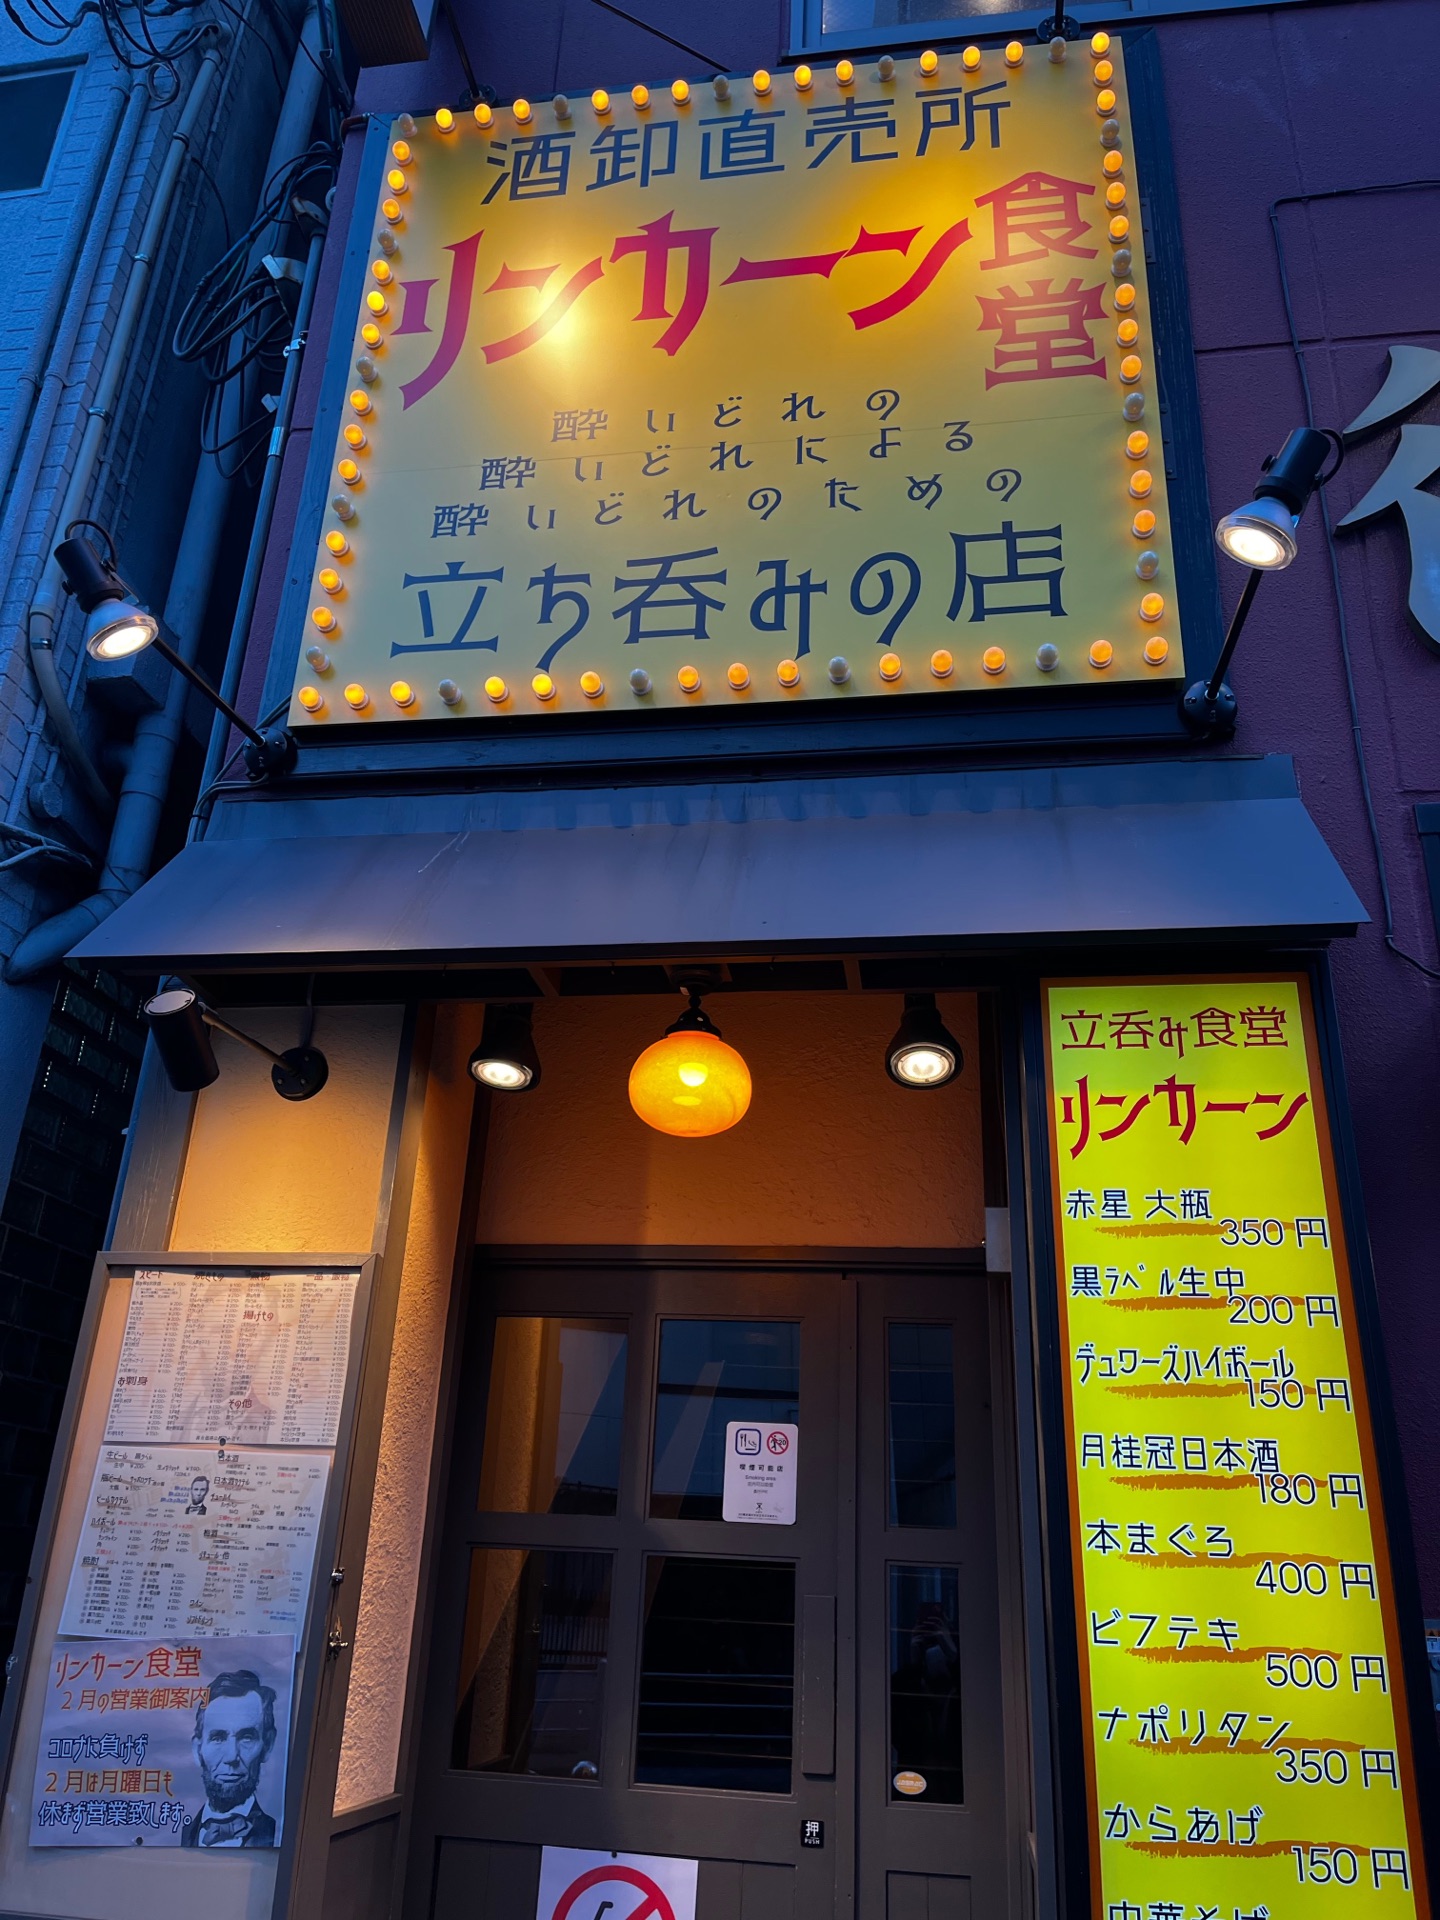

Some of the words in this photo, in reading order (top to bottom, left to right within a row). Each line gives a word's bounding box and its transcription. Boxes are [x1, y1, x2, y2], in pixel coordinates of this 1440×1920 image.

[480, 81, 1011, 205] 酒卸直売所
[975, 170, 1108, 391] 食堂
[391, 210, 973, 411] リンカーン
[551, 388, 901, 443] 酔いどれの
[479, 421, 975, 491] 酔いどれによる
[430, 469, 1022, 540] 酔いどれのための
[390, 521, 1068, 674] 立ち呑みの店
[1061, 1006, 1289, 1059] 立呑み食堂
[1060, 1074, 1309, 1160] リンカーン
[1066, 1190, 1132, 1220] 赤星
[117, 1376, 148, 1388] お刺身
[1076, 1342, 1295, 1384] デュワーズハイボール
[228, 1398, 252, 1410] その他
[1081, 1433, 1279, 1473] 月桂冠日本酒
[745, 1474, 766, 1482] Smoking
[1086, 1518, 1233, 1558] 本まぐろ
[1091, 1609, 1240, 1653] ビフテキ
[56, 1646, 203, 1689] リンカーン食堂
[1098, 1704, 1292, 1749] ナポリタン
[48, 1733, 149, 1766] コロナに負けず
[38, 1800, 193, 1834] 休まず営業致します。
[805, 1820, 819, 1837] 押
[1104, 1803, 1264, 1845] からあげ
